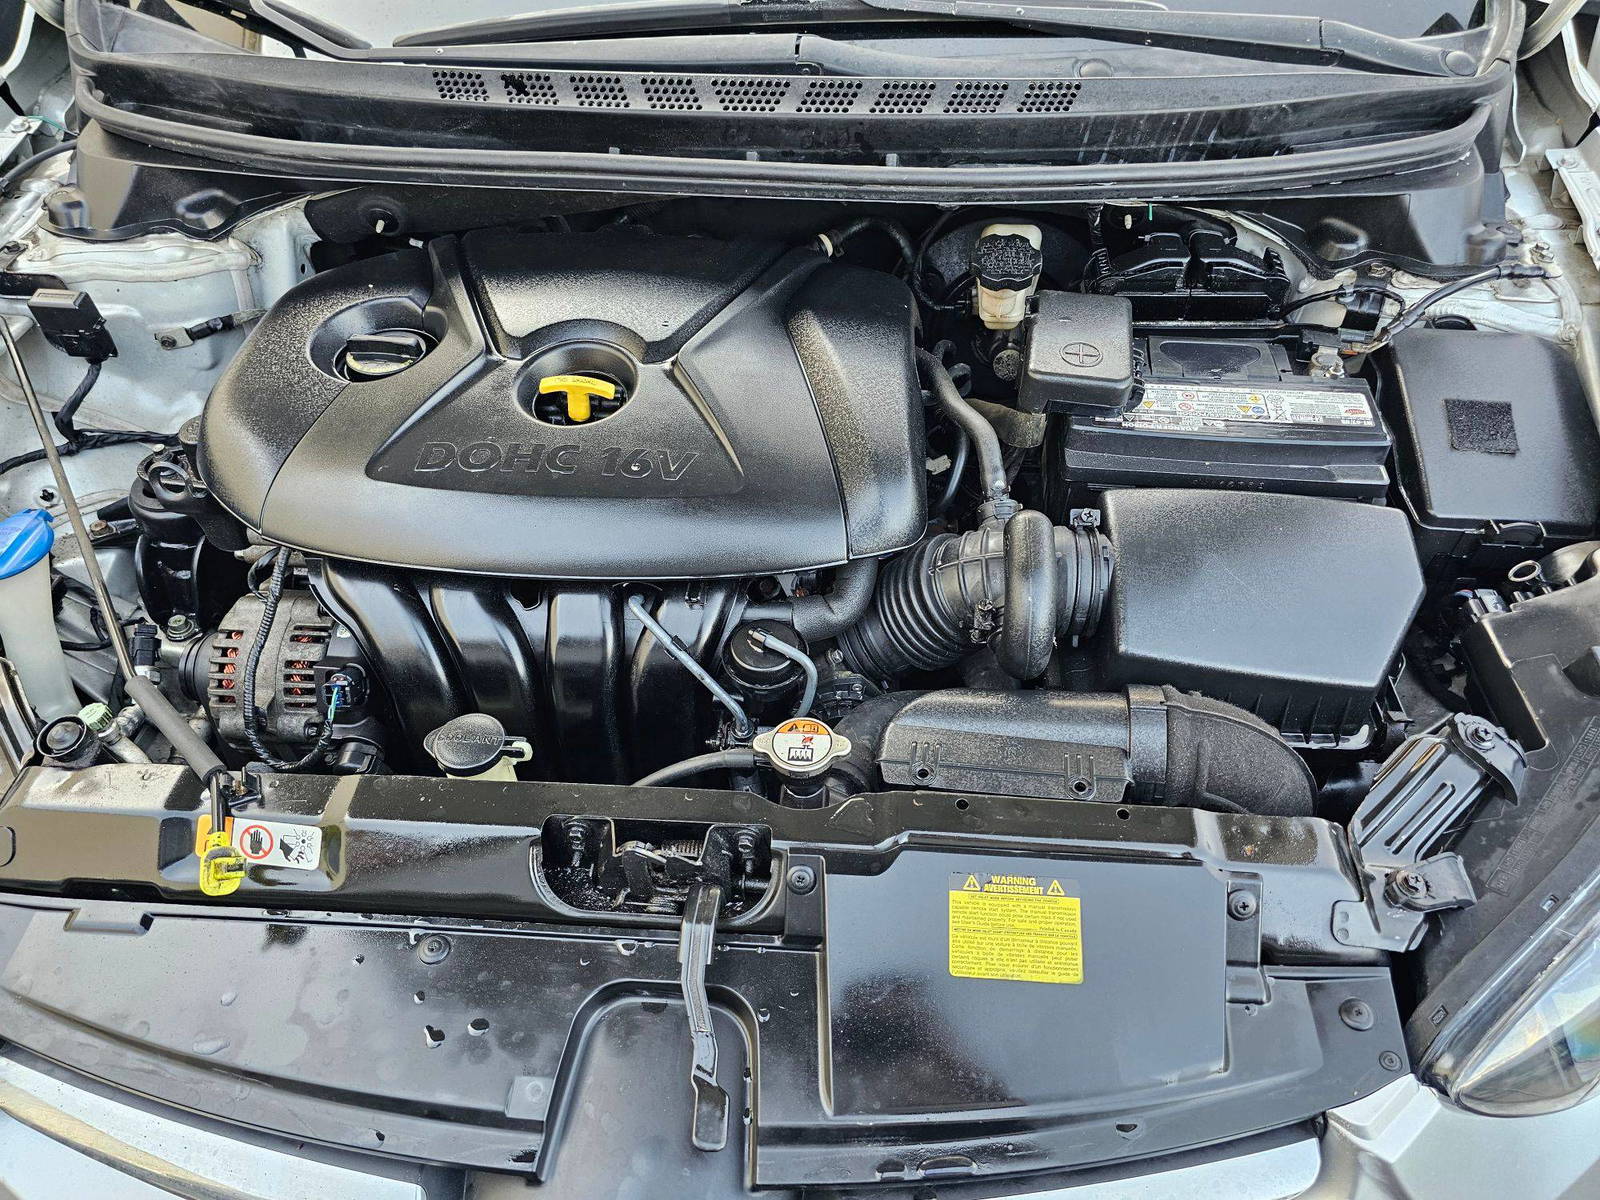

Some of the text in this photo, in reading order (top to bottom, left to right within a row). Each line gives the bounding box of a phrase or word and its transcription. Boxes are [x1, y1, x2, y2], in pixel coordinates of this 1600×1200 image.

[414, 441, 698, 480] DOHC 16V
[991, 875, 1036, 886] WARNING
[984, 884, 1044, 895] AVERTISSEMENT
